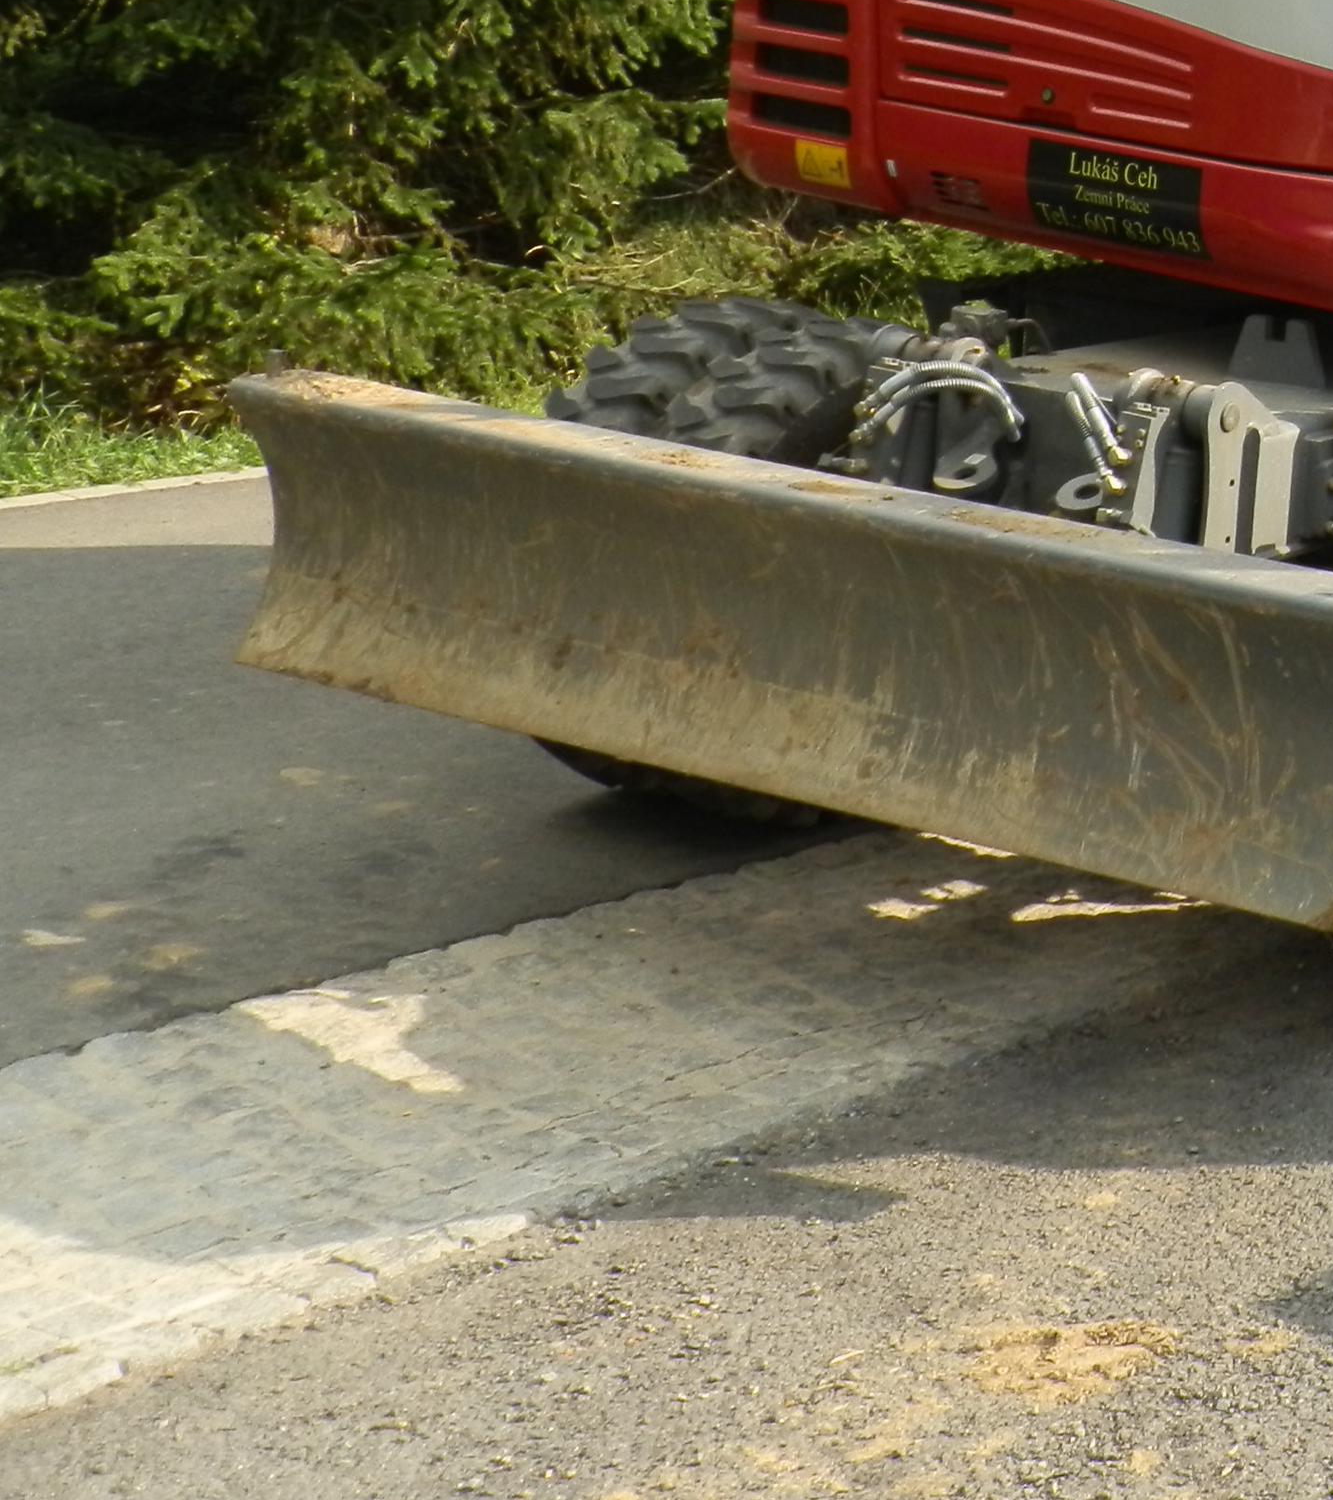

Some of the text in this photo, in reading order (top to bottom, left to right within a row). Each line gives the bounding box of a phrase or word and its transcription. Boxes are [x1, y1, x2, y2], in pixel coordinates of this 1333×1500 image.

[1068, 151, 1158, 190] Lukáš Ceh
[1162, 227, 1201, 253] 943
